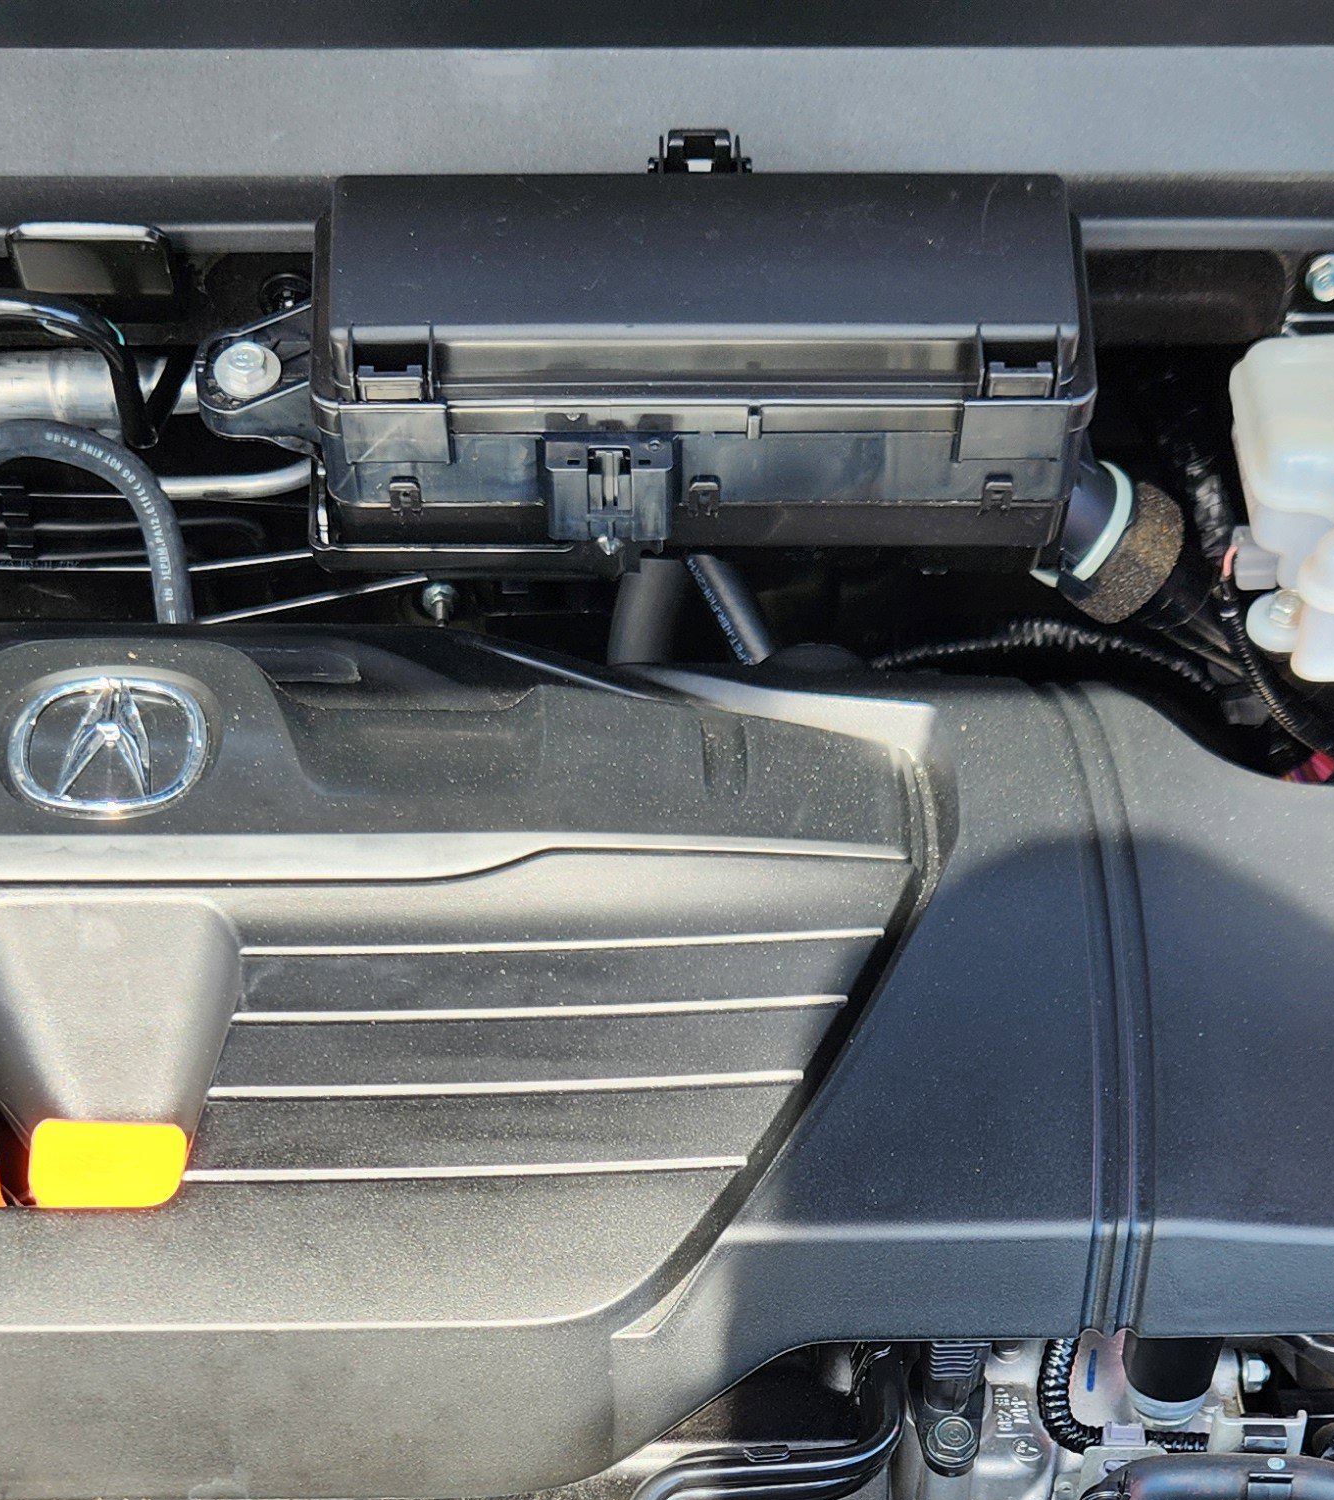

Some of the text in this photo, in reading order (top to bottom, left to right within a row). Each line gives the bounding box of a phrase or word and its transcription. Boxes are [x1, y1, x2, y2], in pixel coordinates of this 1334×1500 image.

[80, 442, 106, 461] KINK
[102, 452, 123, 472] NOT
[122, 468, 137, 484] DO
